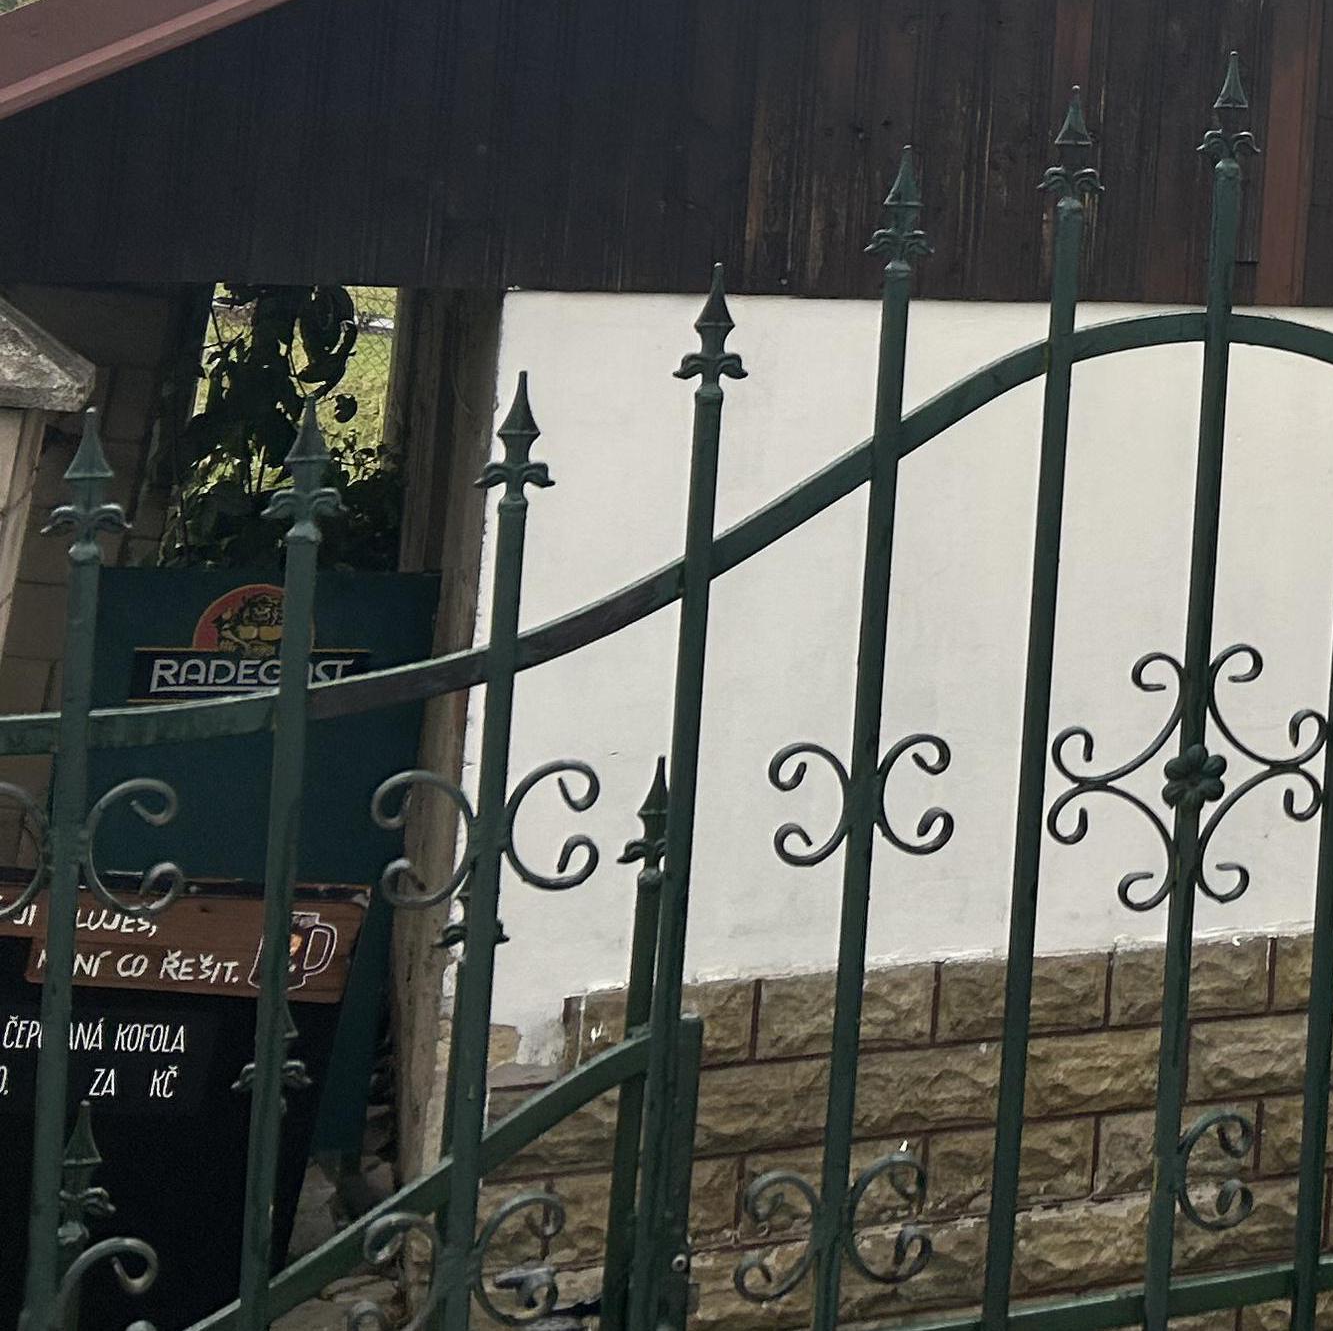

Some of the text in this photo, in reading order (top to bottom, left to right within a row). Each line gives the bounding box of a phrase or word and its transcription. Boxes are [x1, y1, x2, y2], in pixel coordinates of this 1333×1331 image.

[151, 659, 354, 691] RADEGST
[75, 909, 157, 937] LUJE,
[37, 949, 239, 983] NÍ CO ŘEŠIT.
[2, 1015, 185, 1053] ČEPNÁ KOFOLA
[88, 1065, 178, 1098] ZA KČ
